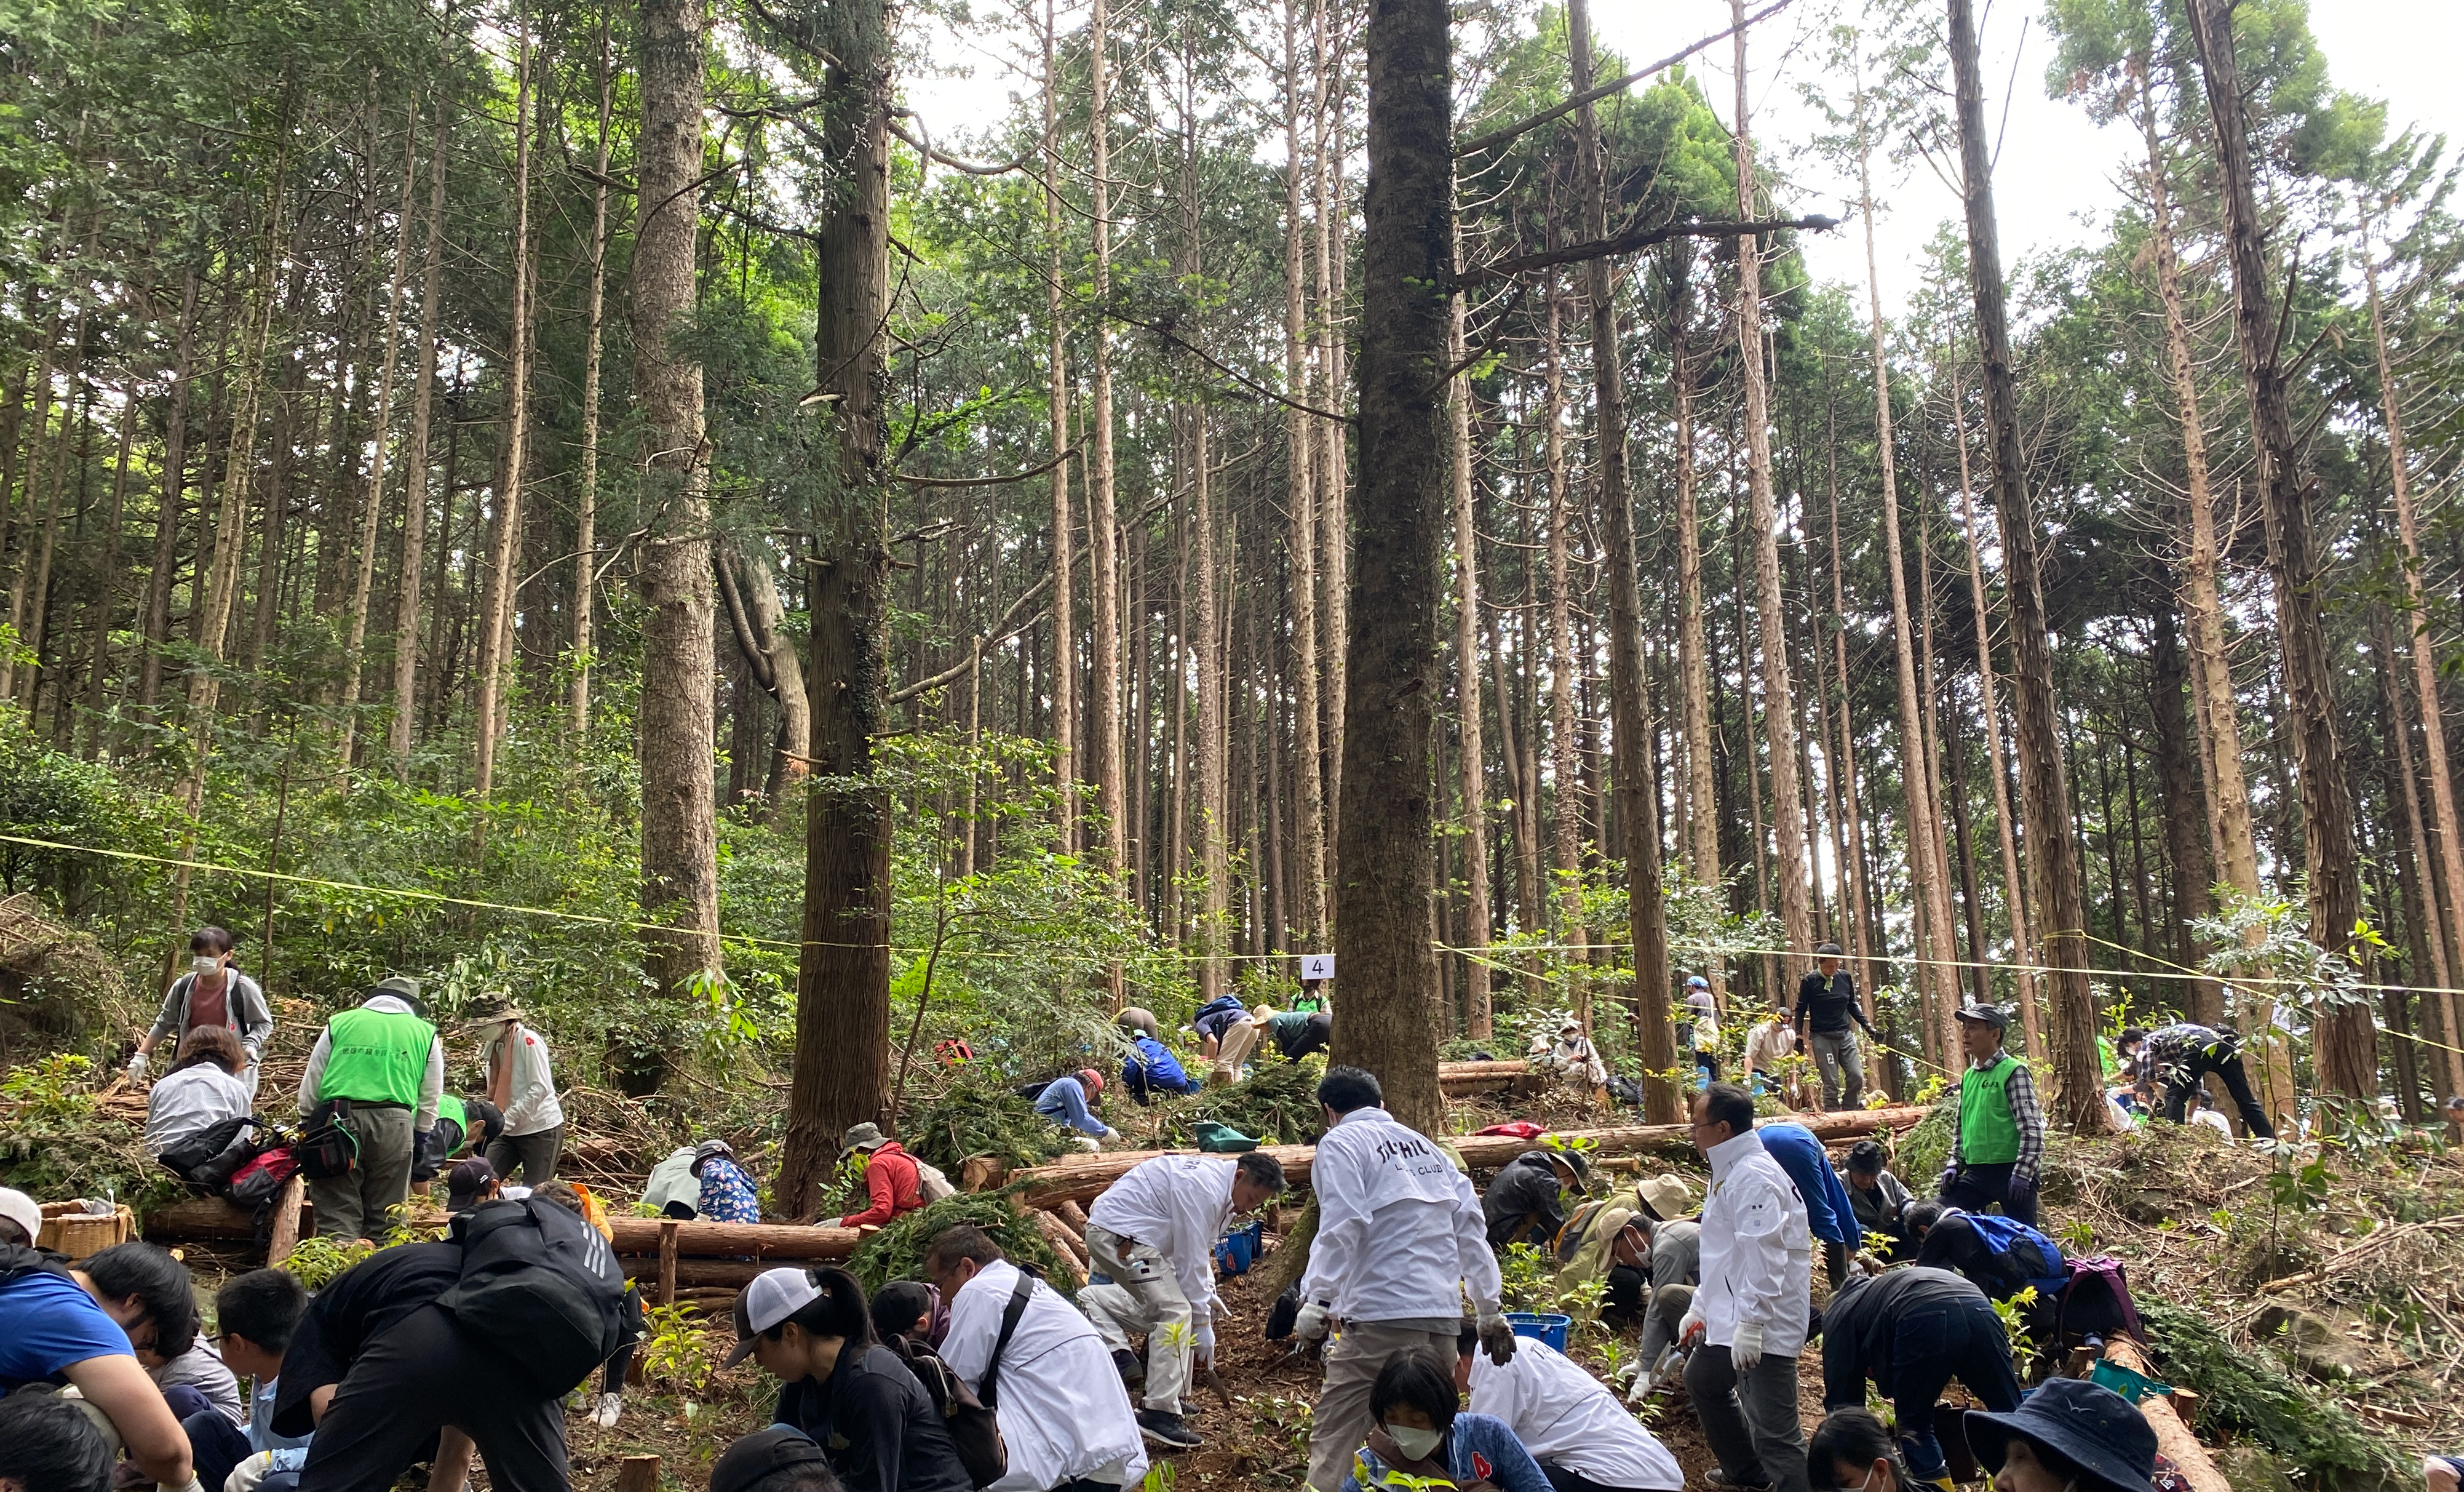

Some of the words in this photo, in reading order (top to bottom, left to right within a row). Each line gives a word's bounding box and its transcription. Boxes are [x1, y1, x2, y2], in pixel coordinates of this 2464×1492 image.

[1312, 959, 1324, 975] 4
[1418, 1164, 1443, 1175] CLUB
[1472, 1451, 1492, 1480] 4
